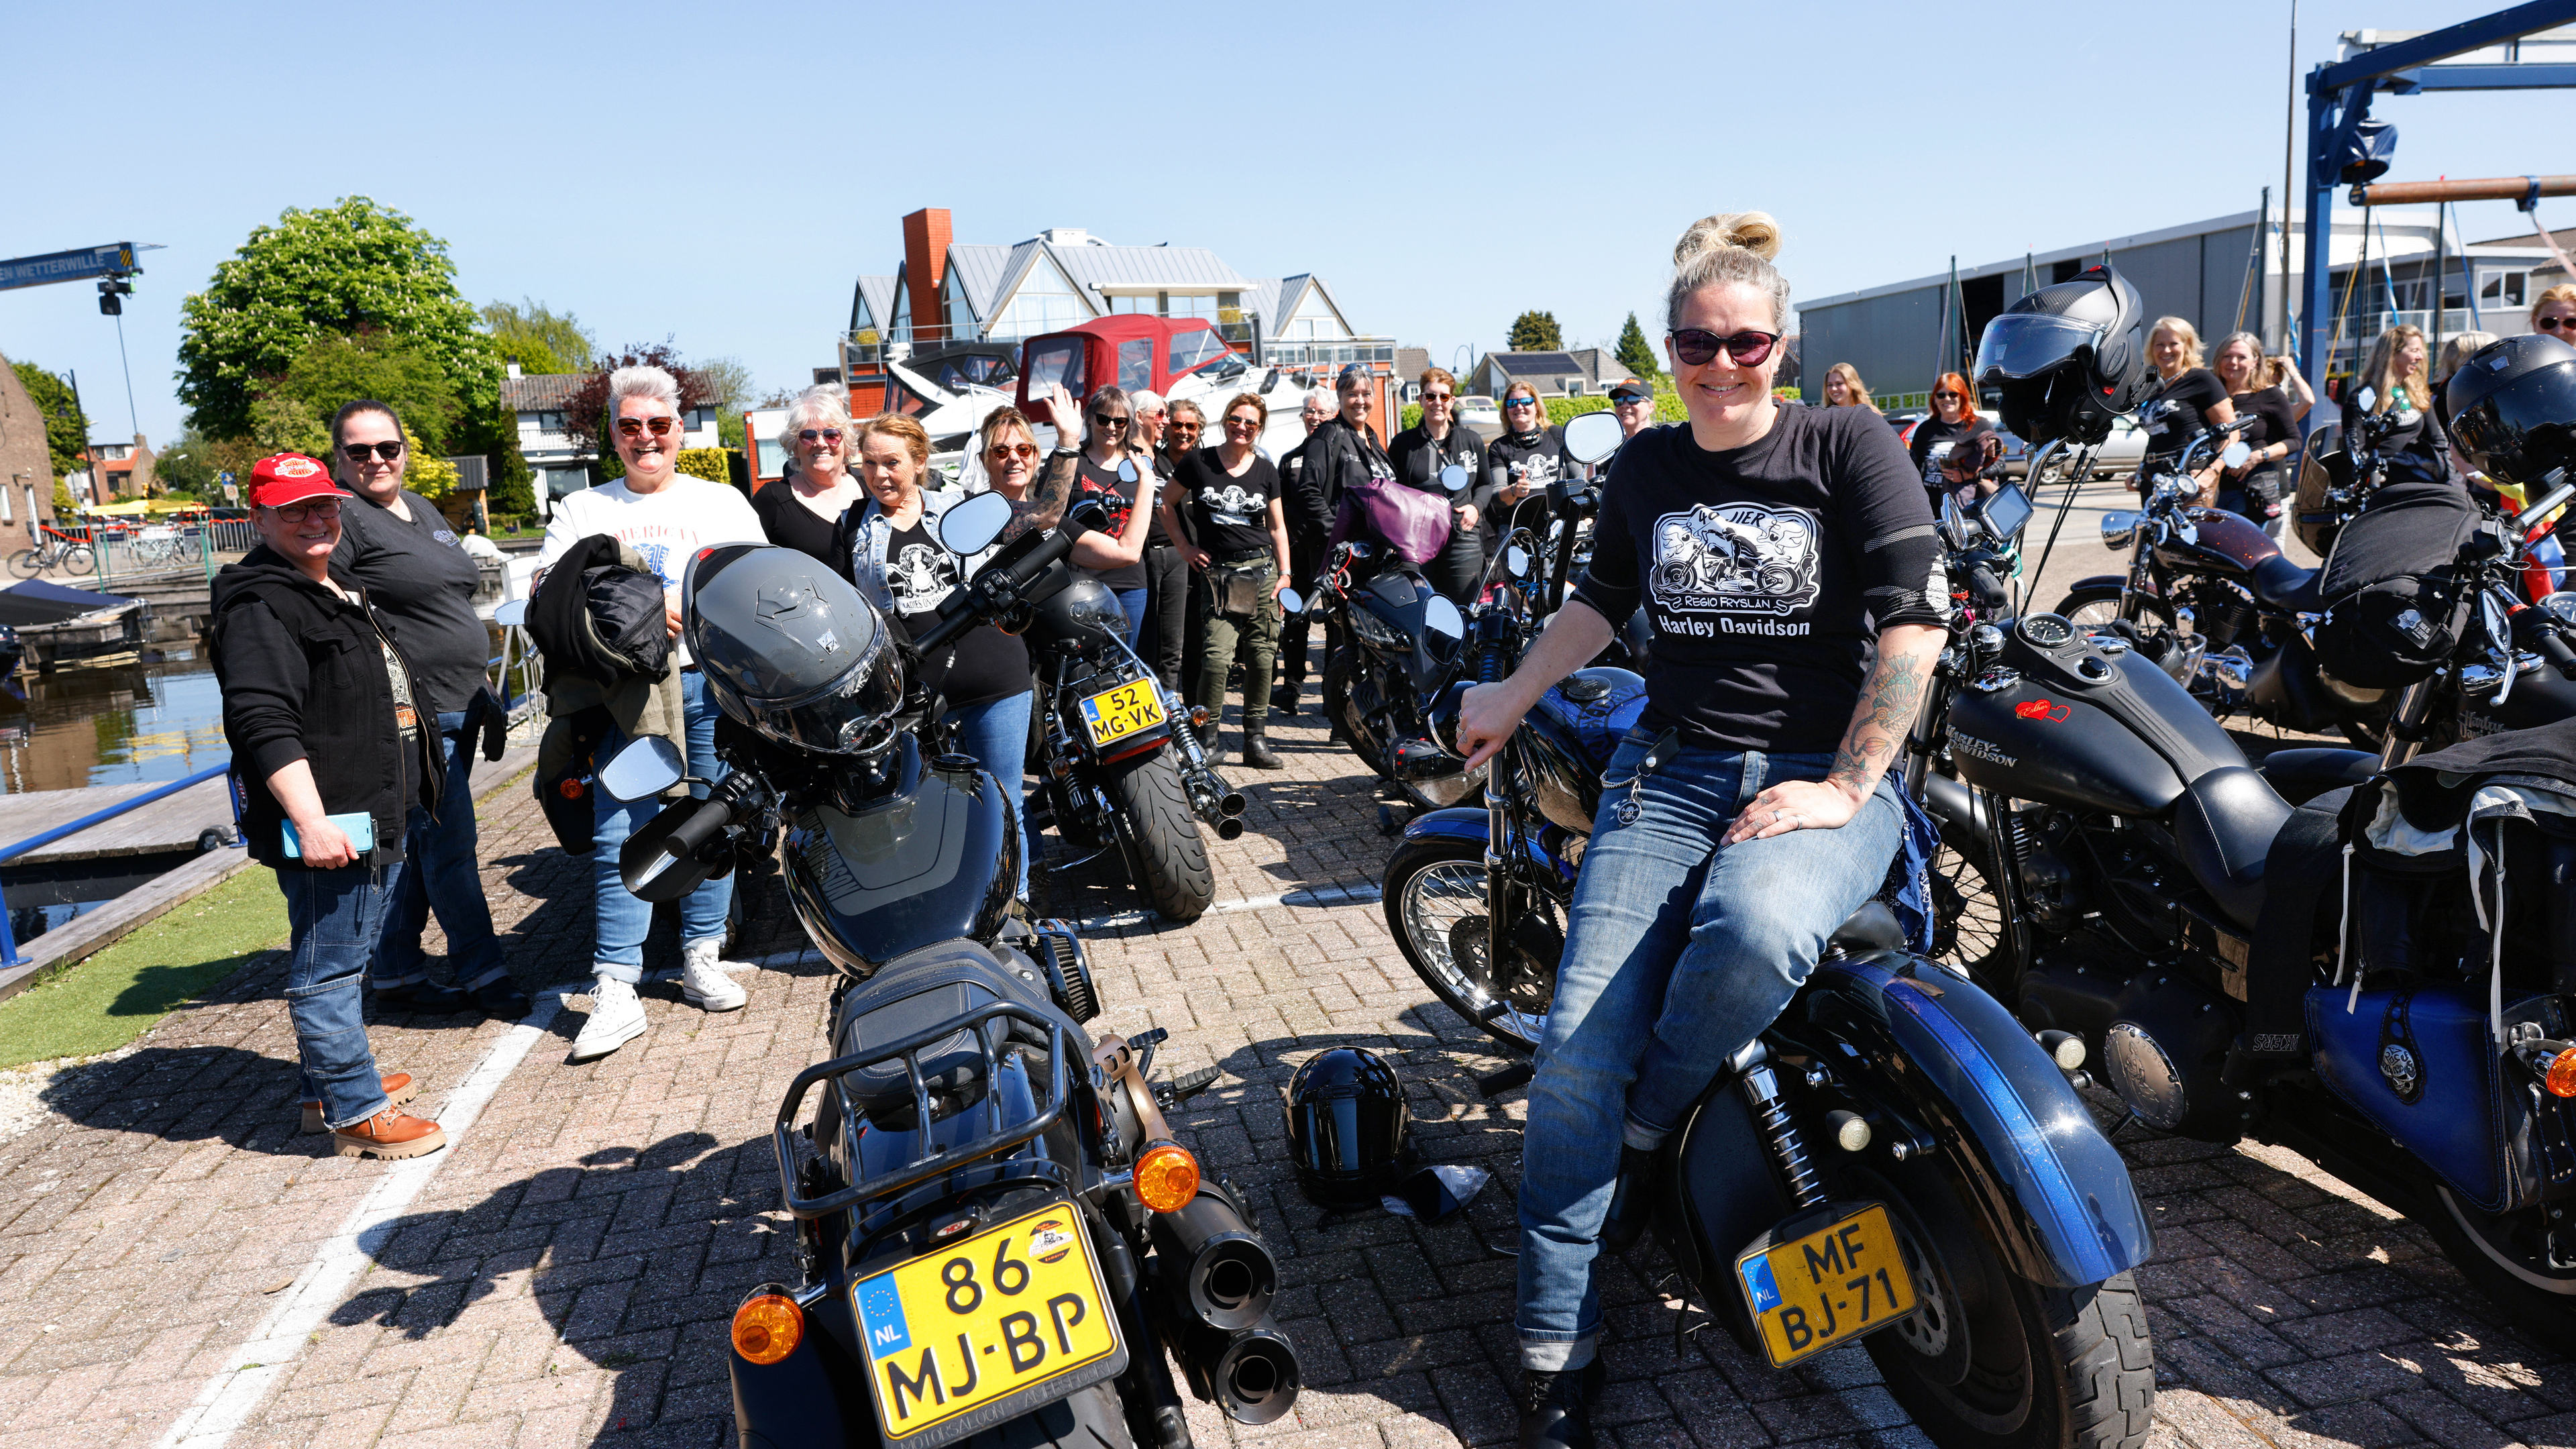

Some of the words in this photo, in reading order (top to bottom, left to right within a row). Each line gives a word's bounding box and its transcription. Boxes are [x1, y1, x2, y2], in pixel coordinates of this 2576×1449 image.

[15, 254, 105, 278] WETTERWILLE
[1684, 595, 1717, 608] REGIO
[1658, 614, 1714, 637] Harley
[1720, 616, 1811, 637] Davidson
[1110, 688, 1140, 711] 52
[2017, 700, 2049, 720] Esther
[1092, 703, 1160, 741] MG-VK
[1948, 738, 2018, 768] DAVIDSON
[1802, 1223, 1864, 1285] MF
[941, 1237, 1030, 1315] 86
[1756, 1288, 1775, 1303] NL
[1780, 1267, 1898, 1352] BJ-71
[875, 1324, 902, 1346] NL
[886, 1292, 1087, 1420] MJ-BP
[900, 1401, 1005, 1449] MOTORSALOON
[1024, 1360, 1112, 1408] AMERSFOORT
